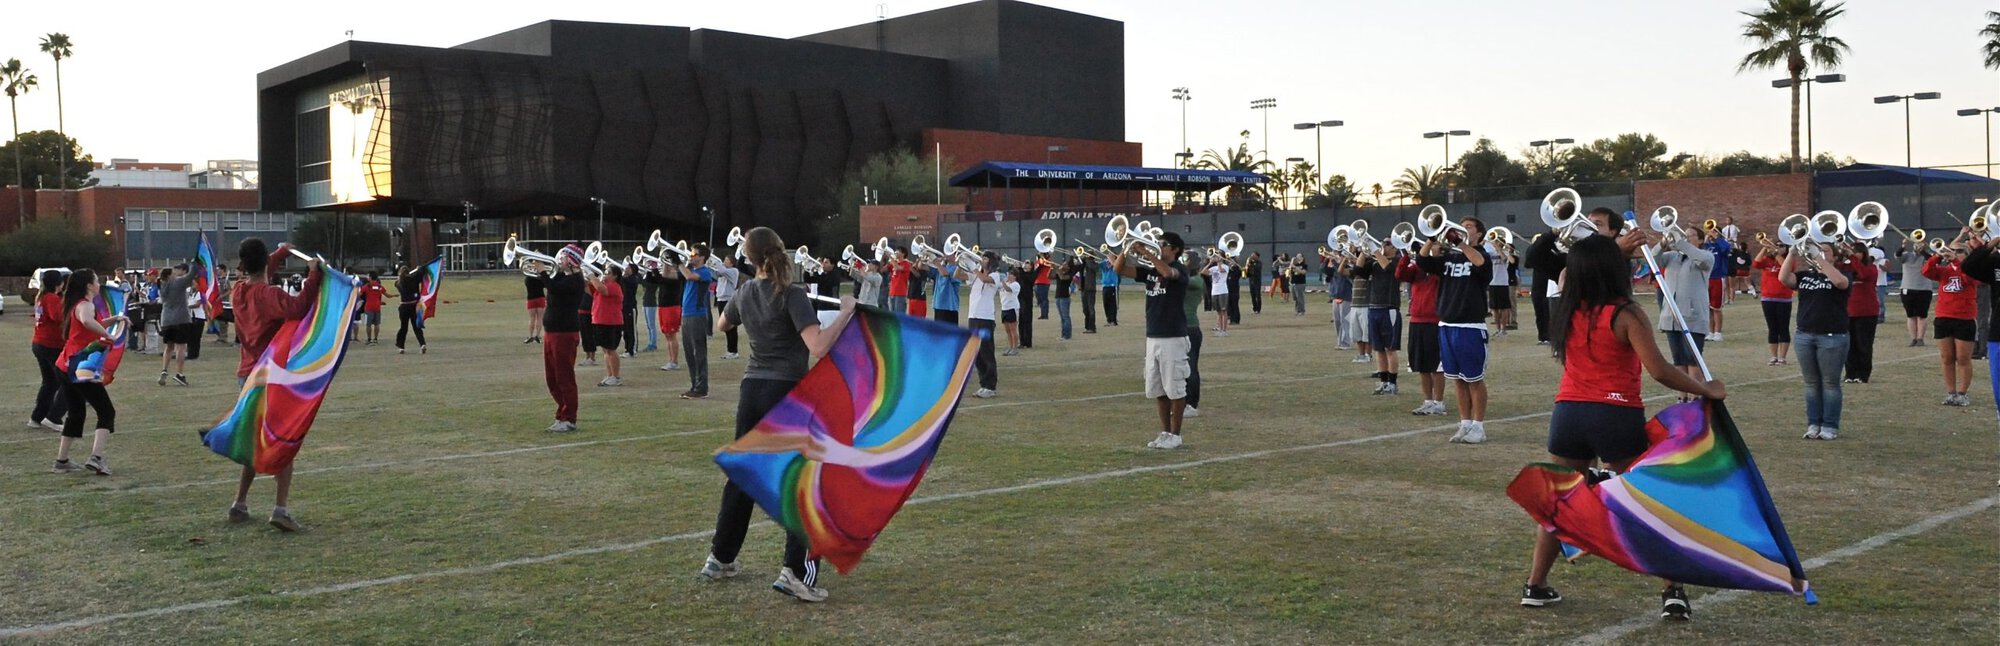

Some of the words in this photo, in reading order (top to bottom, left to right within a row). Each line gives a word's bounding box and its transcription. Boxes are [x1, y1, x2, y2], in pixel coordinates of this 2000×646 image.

[1015, 168, 1029, 177] THE
[1038, 170, 1077, 179] UNIVERSITY
[1102, 172, 1132, 181] ARIZONA
[1187, 175, 1211, 183] ROBSON
